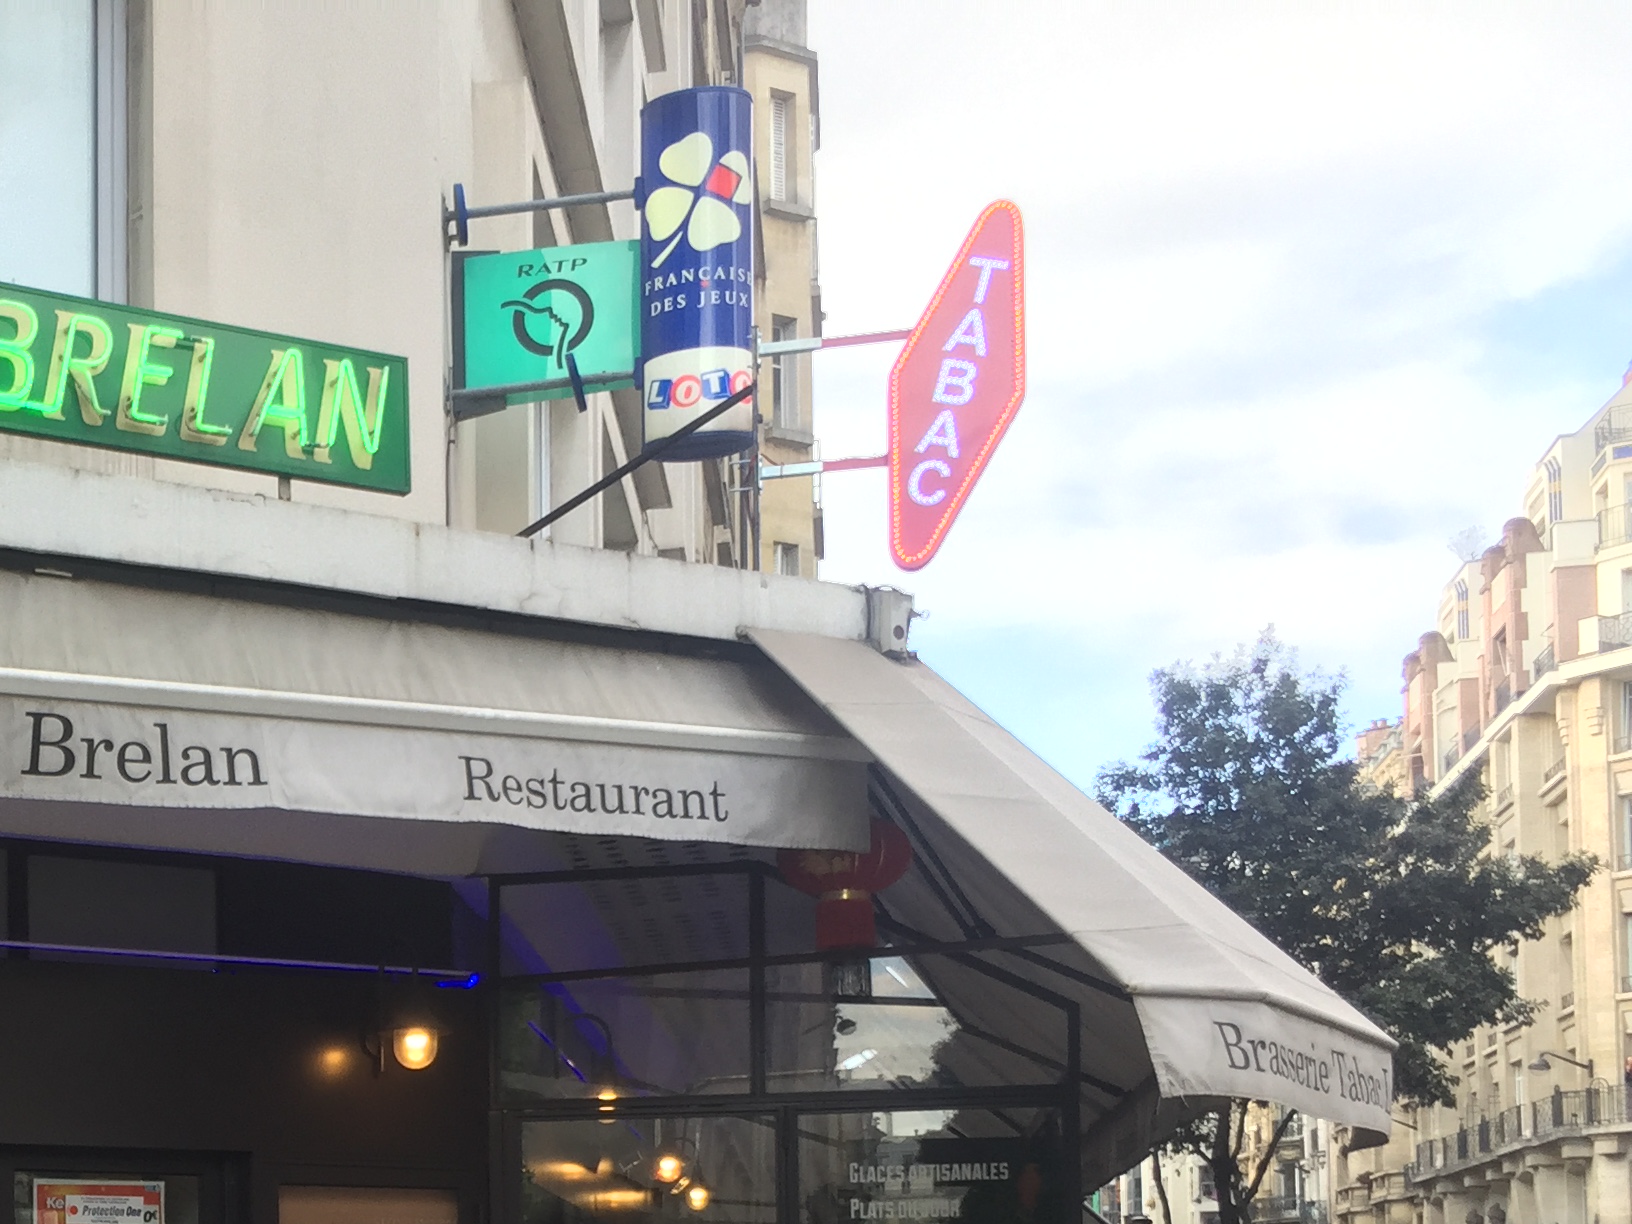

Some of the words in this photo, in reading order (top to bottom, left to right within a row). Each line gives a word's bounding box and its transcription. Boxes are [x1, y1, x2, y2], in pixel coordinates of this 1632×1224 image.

[516, 256, 589, 279] RATP
[649, 292, 688, 317] DES
[696, 289, 750, 310] JEUX
[907, 255, 1011, 507] TABAC
[20, 711, 269, 788] Brelan
[458, 754, 730, 823] Restaurant
[1213, 1020, 1330, 1097] Brasserie
[849, 1162, 905, 1183] GLACES
[909, 1162, 1010, 1182] ARTISANALES
[82, 1205, 125, 1217] Protection
[850, 1198, 894, 1219] PLATS
